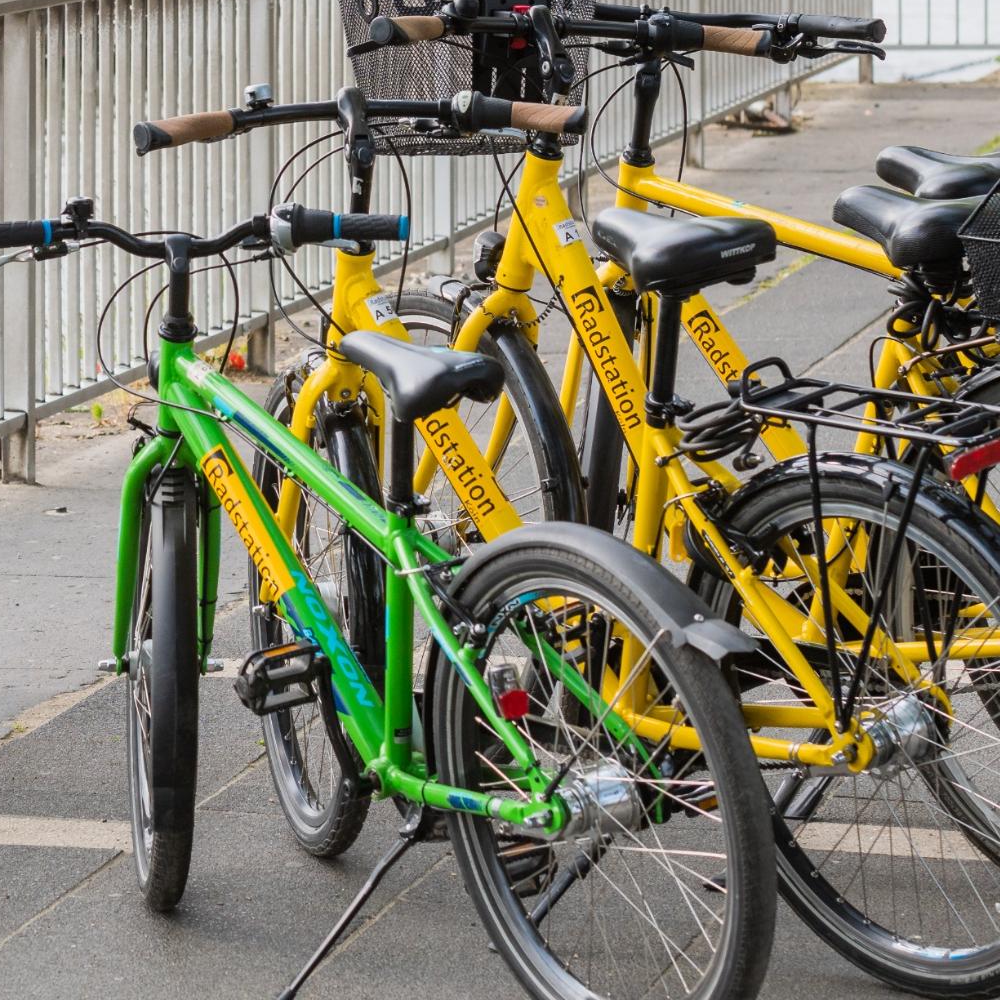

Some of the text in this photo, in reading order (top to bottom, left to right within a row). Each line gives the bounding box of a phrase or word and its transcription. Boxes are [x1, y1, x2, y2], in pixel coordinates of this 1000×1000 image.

[721, 243, 756, 259] WITTKOP
[575, 298, 642, 430] Radstation
[208, 463, 280, 596] Radstation
[290, 570, 375, 707] NOXON
